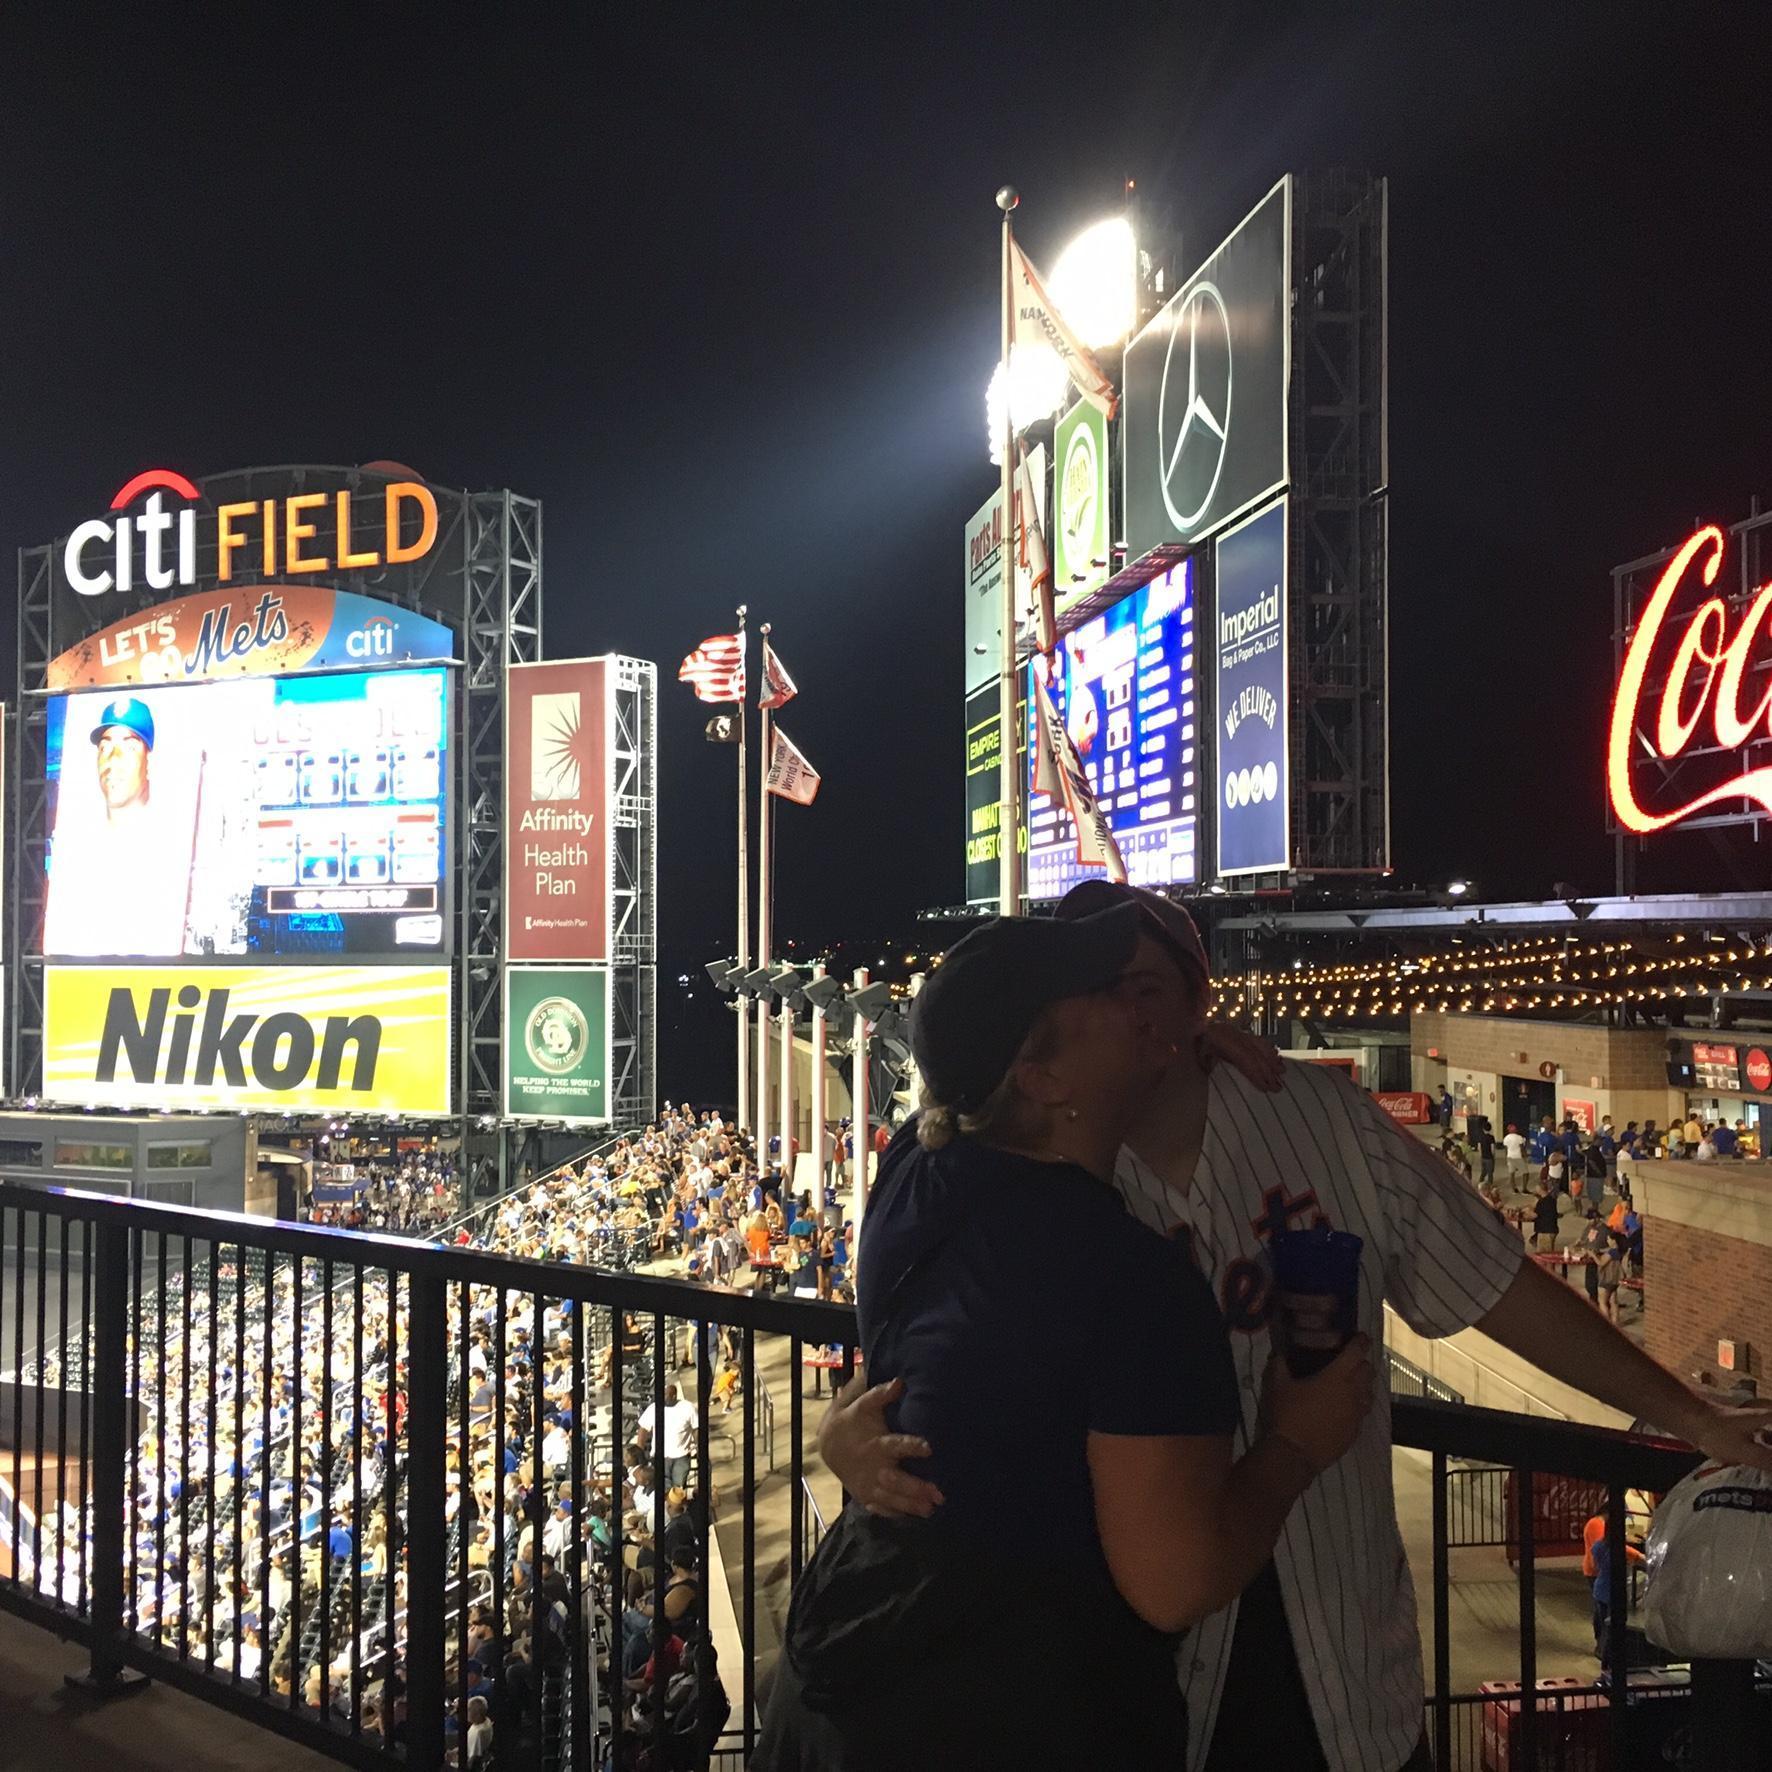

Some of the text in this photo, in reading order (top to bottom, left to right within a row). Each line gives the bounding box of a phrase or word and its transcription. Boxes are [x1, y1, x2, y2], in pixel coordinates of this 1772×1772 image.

[65, 481, 440, 596] citi FIELD
[1221, 584, 1279, 647] Imperial
[99, 615, 177, 668] LET'S
[184, 591, 289, 675] Mets
[1222, 655, 1233, 669] Bag
[1238, 646, 1254, 662] Paper
[1266, 632, 1280, 650] LLC
[1225, 685, 1278, 740] WE DELIVER
[969, 730, 1000, 761] EMPIRE
[768, 764, 782, 785] NEW
[780, 766, 799, 791] World
[519, 808, 594, 837] Affinity
[524, 842, 589, 867] Health
[967, 834, 997, 865] CLOSEST
[535, 872, 577, 896] Plan
[95, 984, 383, 1092] Nikon
[513, 1076, 601, 1088] HELPING THE WORLD
[522, 1085, 546, 1094] KEEP
[1700, 1491, 1753, 1507] mets
